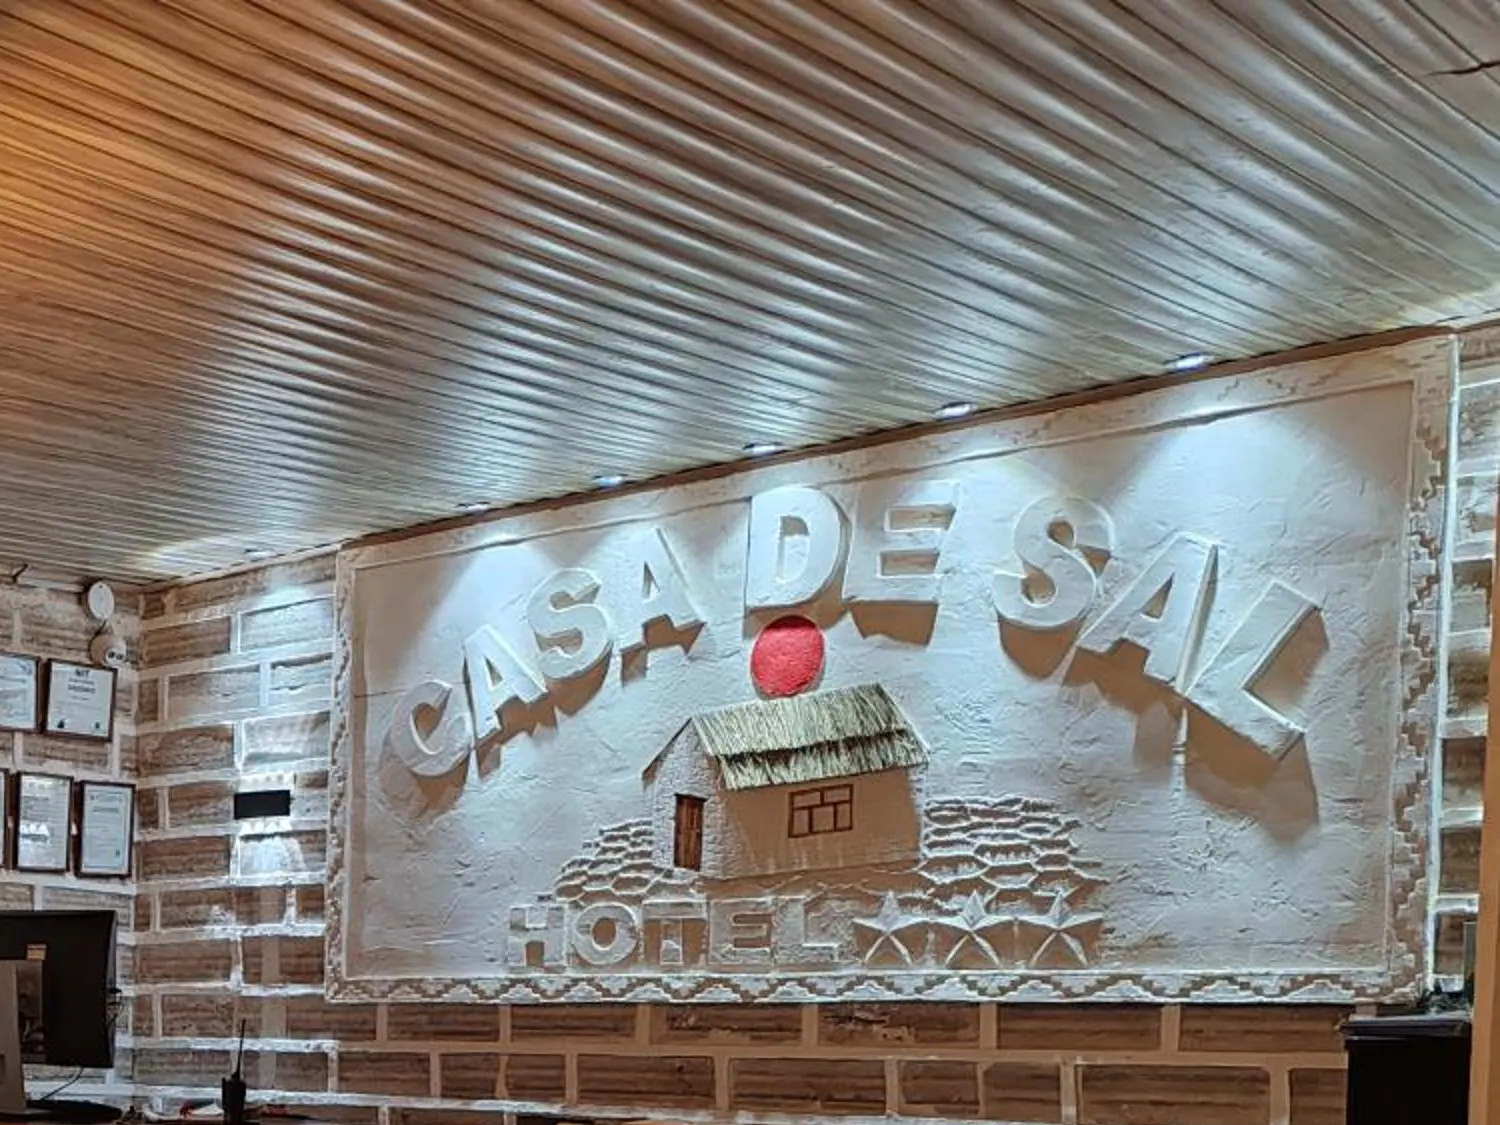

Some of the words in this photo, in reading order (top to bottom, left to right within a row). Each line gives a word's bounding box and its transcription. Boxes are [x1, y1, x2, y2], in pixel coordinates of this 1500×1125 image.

[388, 524, 704, 776] CASA
[744, 480, 960, 608] DE
[992, 494, 1324, 758] SAL
[507, 896, 840, 966] HOTEL
